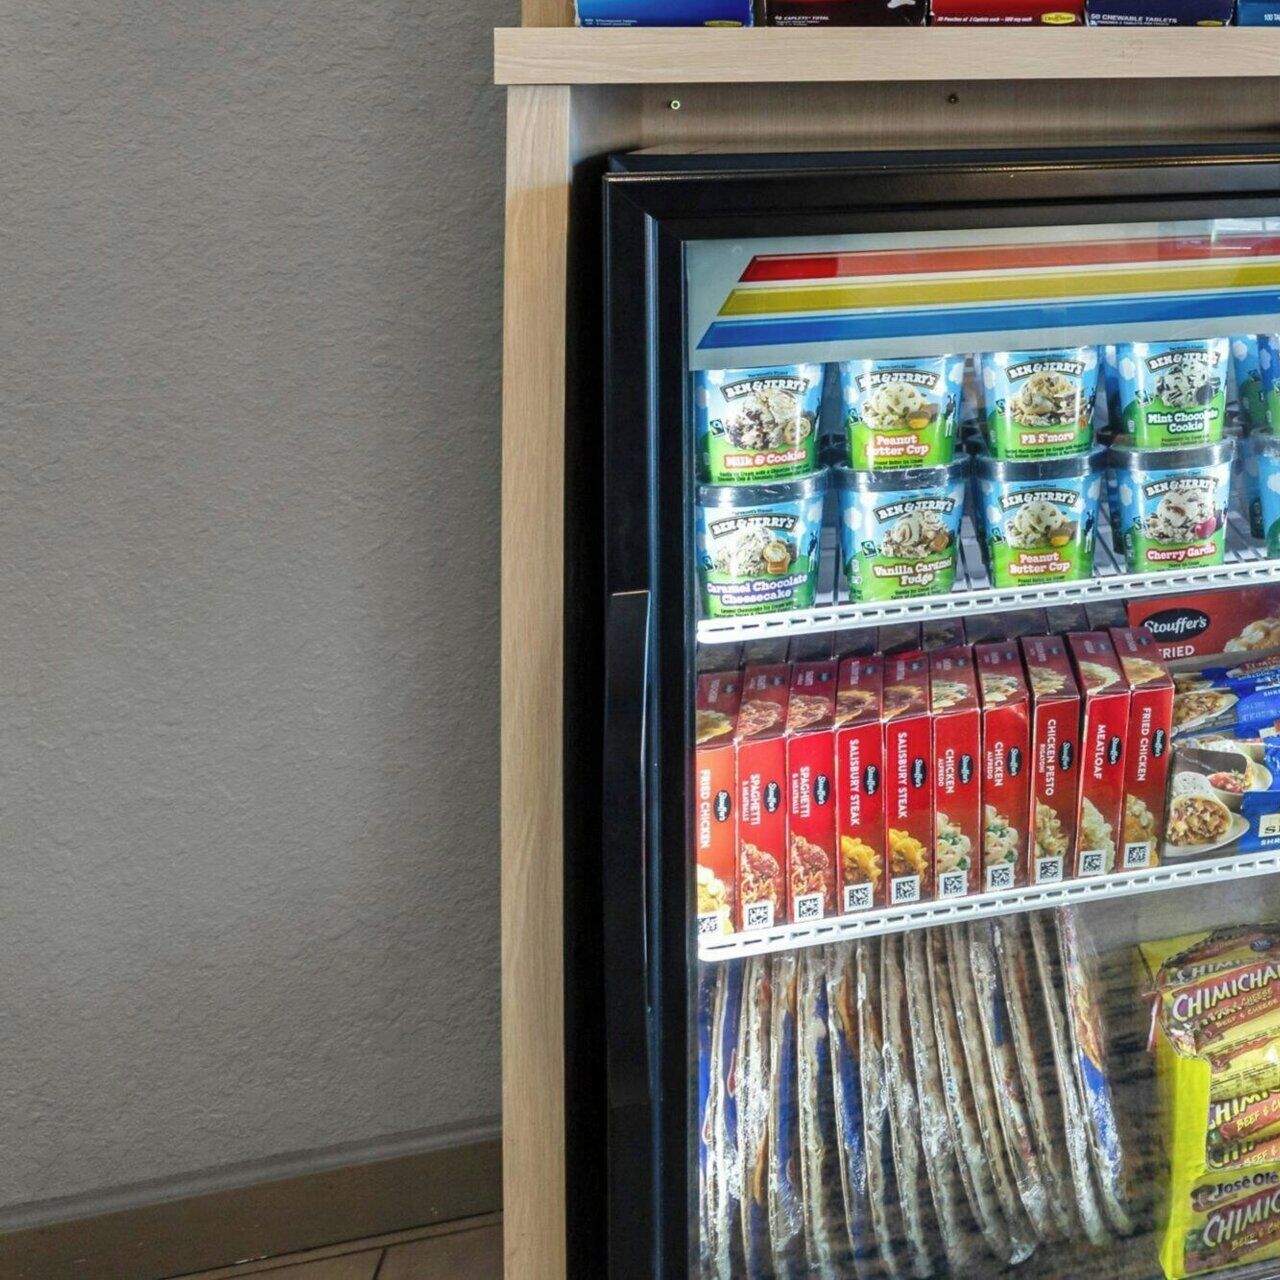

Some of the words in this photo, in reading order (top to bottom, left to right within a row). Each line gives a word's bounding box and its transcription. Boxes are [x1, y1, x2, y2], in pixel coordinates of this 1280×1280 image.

[876, 434, 918, 446] Peanut
[1001, 494, 1024, 508] BEN
[1033, 491, 1076, 505] JERRY'S
[1009, 563, 1048, 574] Butter
[1048, 561, 1071, 573] Cup
[1020, 552, 1060, 564] Peanut
[706, 580, 751, 594] Caramel
[752, 573, 808, 592] Chocolate
[901, 573, 934, 587] Fudge
[722, 588, 792, 605] Cheesecake
[1144, 614, 1208, 634] Stouffer's
[1141, 706, 1152, 736] FRIED
[1046, 719, 1057, 761] CHICKEN
[1093, 723, 1107, 780] MEATLOAF
[849, 737, 861, 792] SALISBURY
[897, 731, 909, 786] SALISBURY
[937, 757, 945, 788] ALFREDO
[944, 748, 956, 795] CHICKEN
[986, 750, 994, 780] ALFREDO
[993, 741, 1005, 788] CHICKEN
[1136, 735, 1150, 782] CHICKEN
[799, 765, 811, 818] SPAGHETTI
[1044, 762, 1056, 797] PESTO
[750, 773, 762, 826] SPAGHETTI
[849, 792, 861, 826] STEAK
[897, 785, 909, 820] STEAK
[1236, 1112, 1260, 1132] BEEF
[1252, 1170, 1280, 1187] Olé
